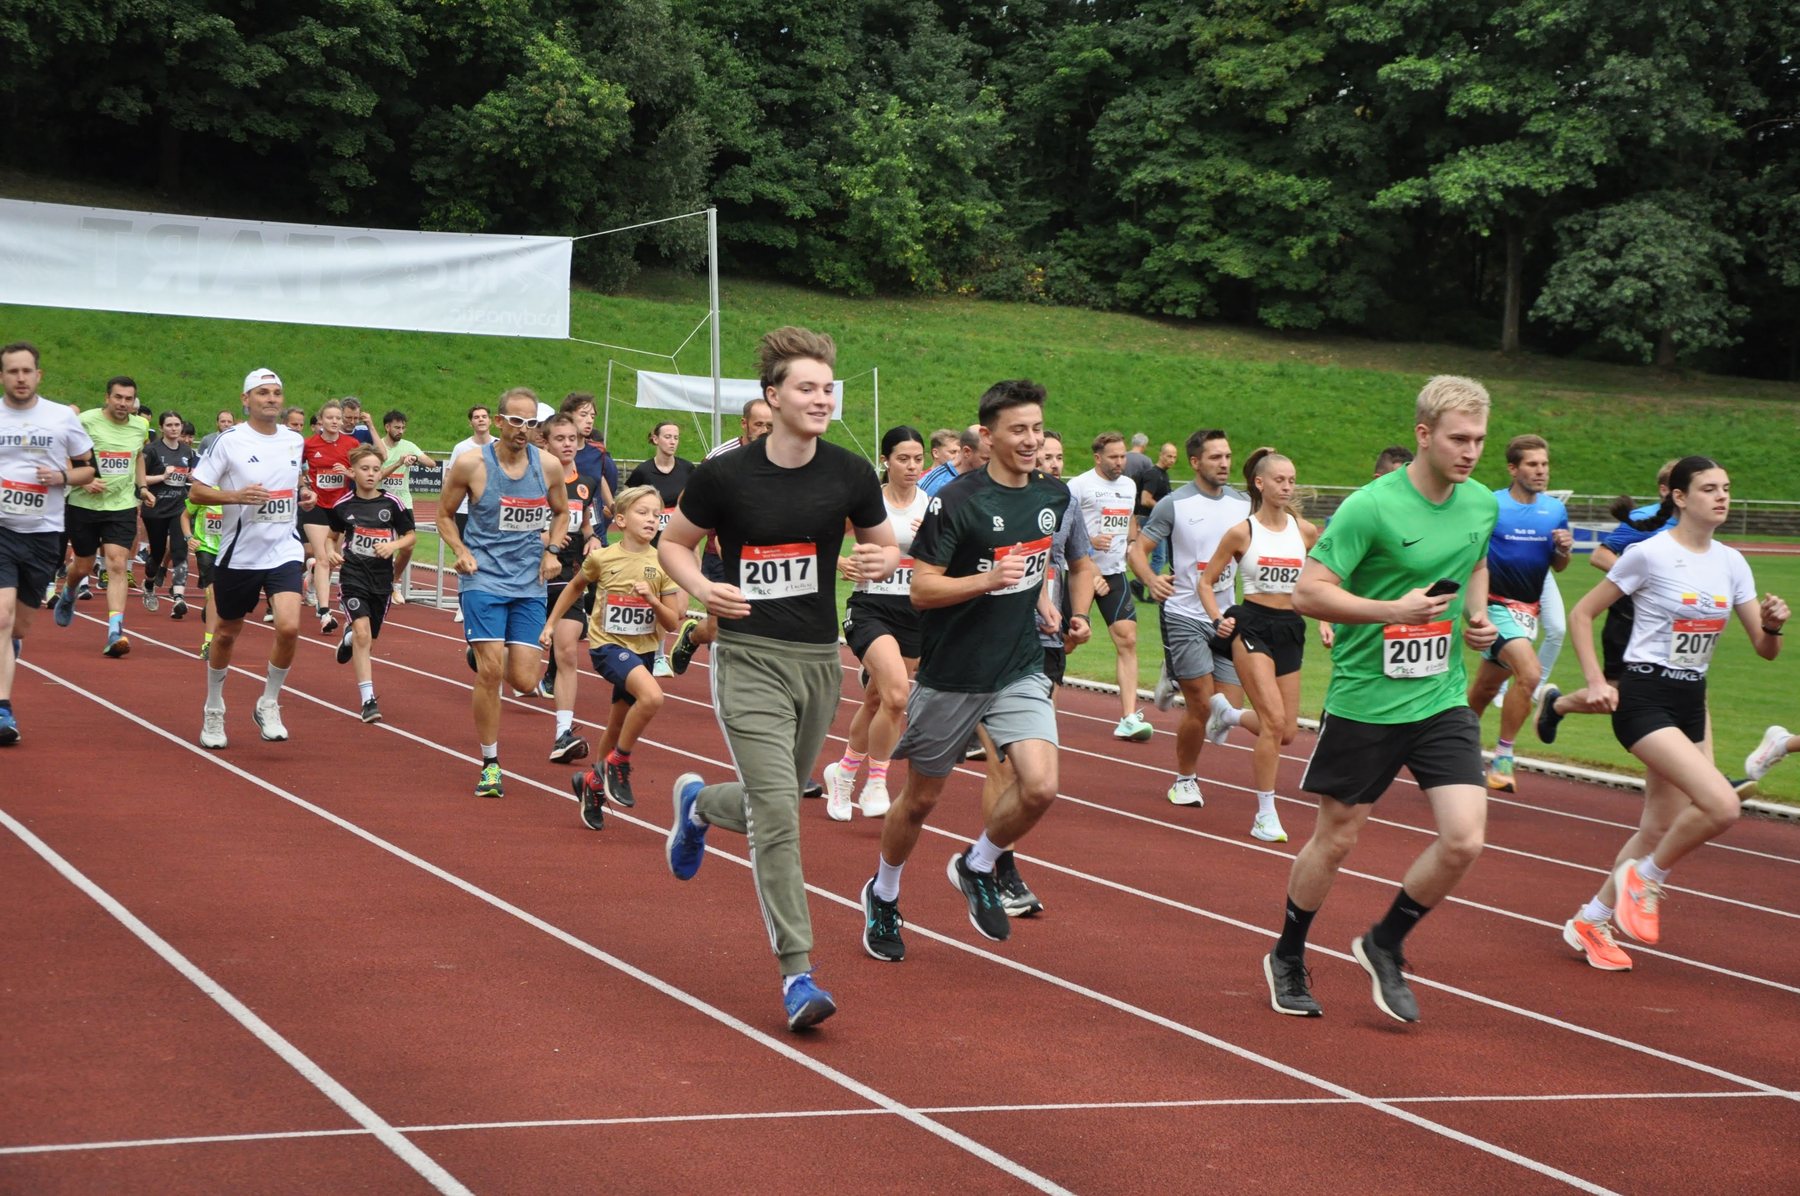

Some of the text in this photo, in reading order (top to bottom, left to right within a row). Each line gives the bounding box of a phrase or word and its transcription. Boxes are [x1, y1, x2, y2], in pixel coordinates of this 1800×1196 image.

[101, 457, 129, 469] 2069
[318, 474, 342, 484] 2090
[383, 478, 403, 486] 2035
[2, 489, 45, 508] 2096
[257, 498, 291, 514] 2091
[503, 507, 543, 523] 2059
[1104, 516, 1129, 528] 2049
[207, 519, 221, 530] 20
[745, 558, 810, 585] 2017
[1024, 552, 1046, 577] 26
[1259, 567, 1299, 584] 2082
[609, 606, 655, 625] 2058
[1390, 637, 1447, 664] 2010
[1660, 669, 1698, 682] NIKE
